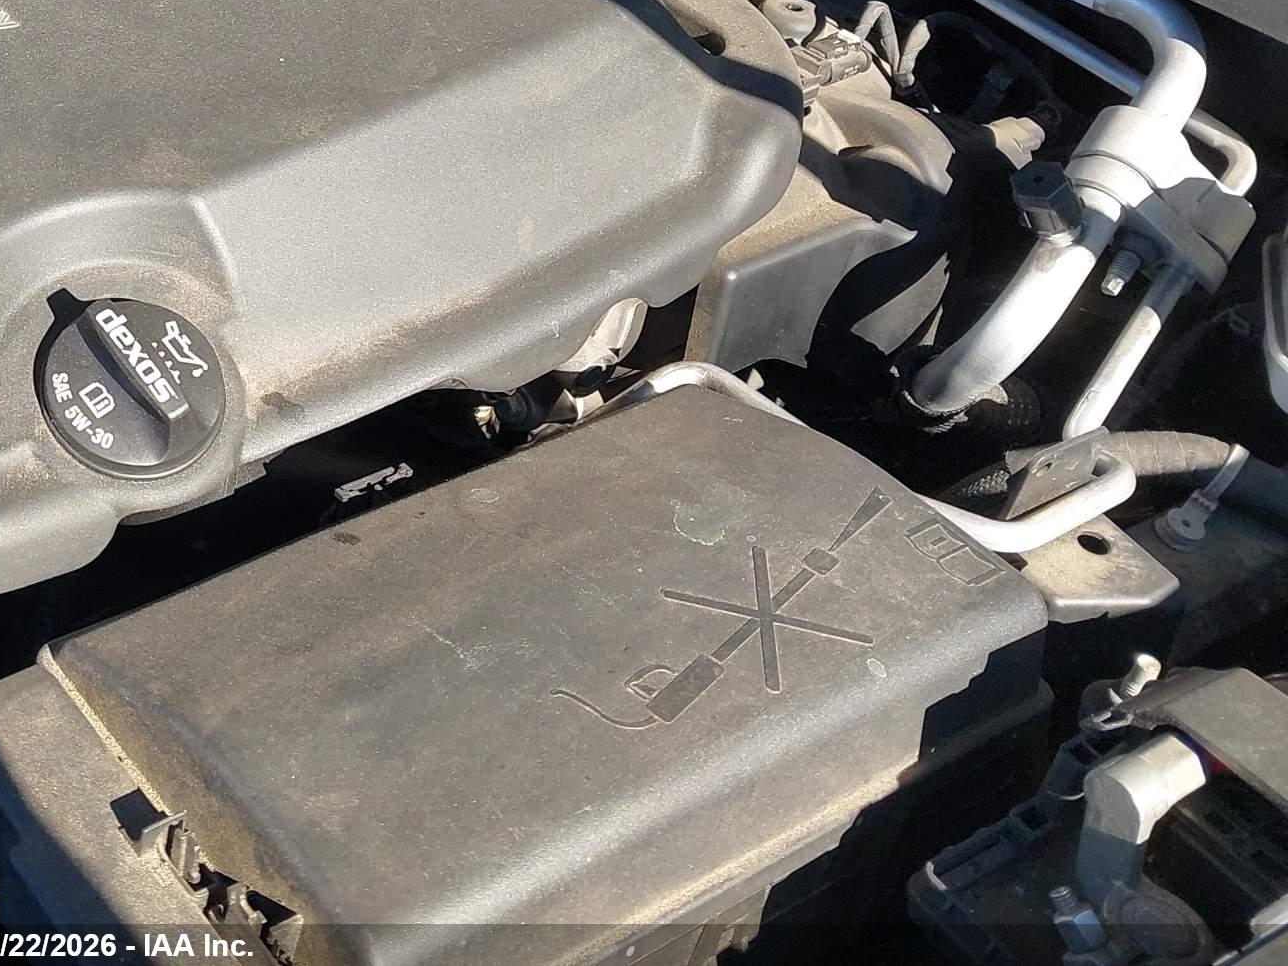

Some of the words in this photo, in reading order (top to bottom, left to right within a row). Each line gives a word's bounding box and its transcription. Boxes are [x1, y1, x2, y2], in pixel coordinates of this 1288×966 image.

[96, 309, 174, 402] dexos
[52, 373, 73, 403] SAE
[65, 405, 114, 449] 5W-30
